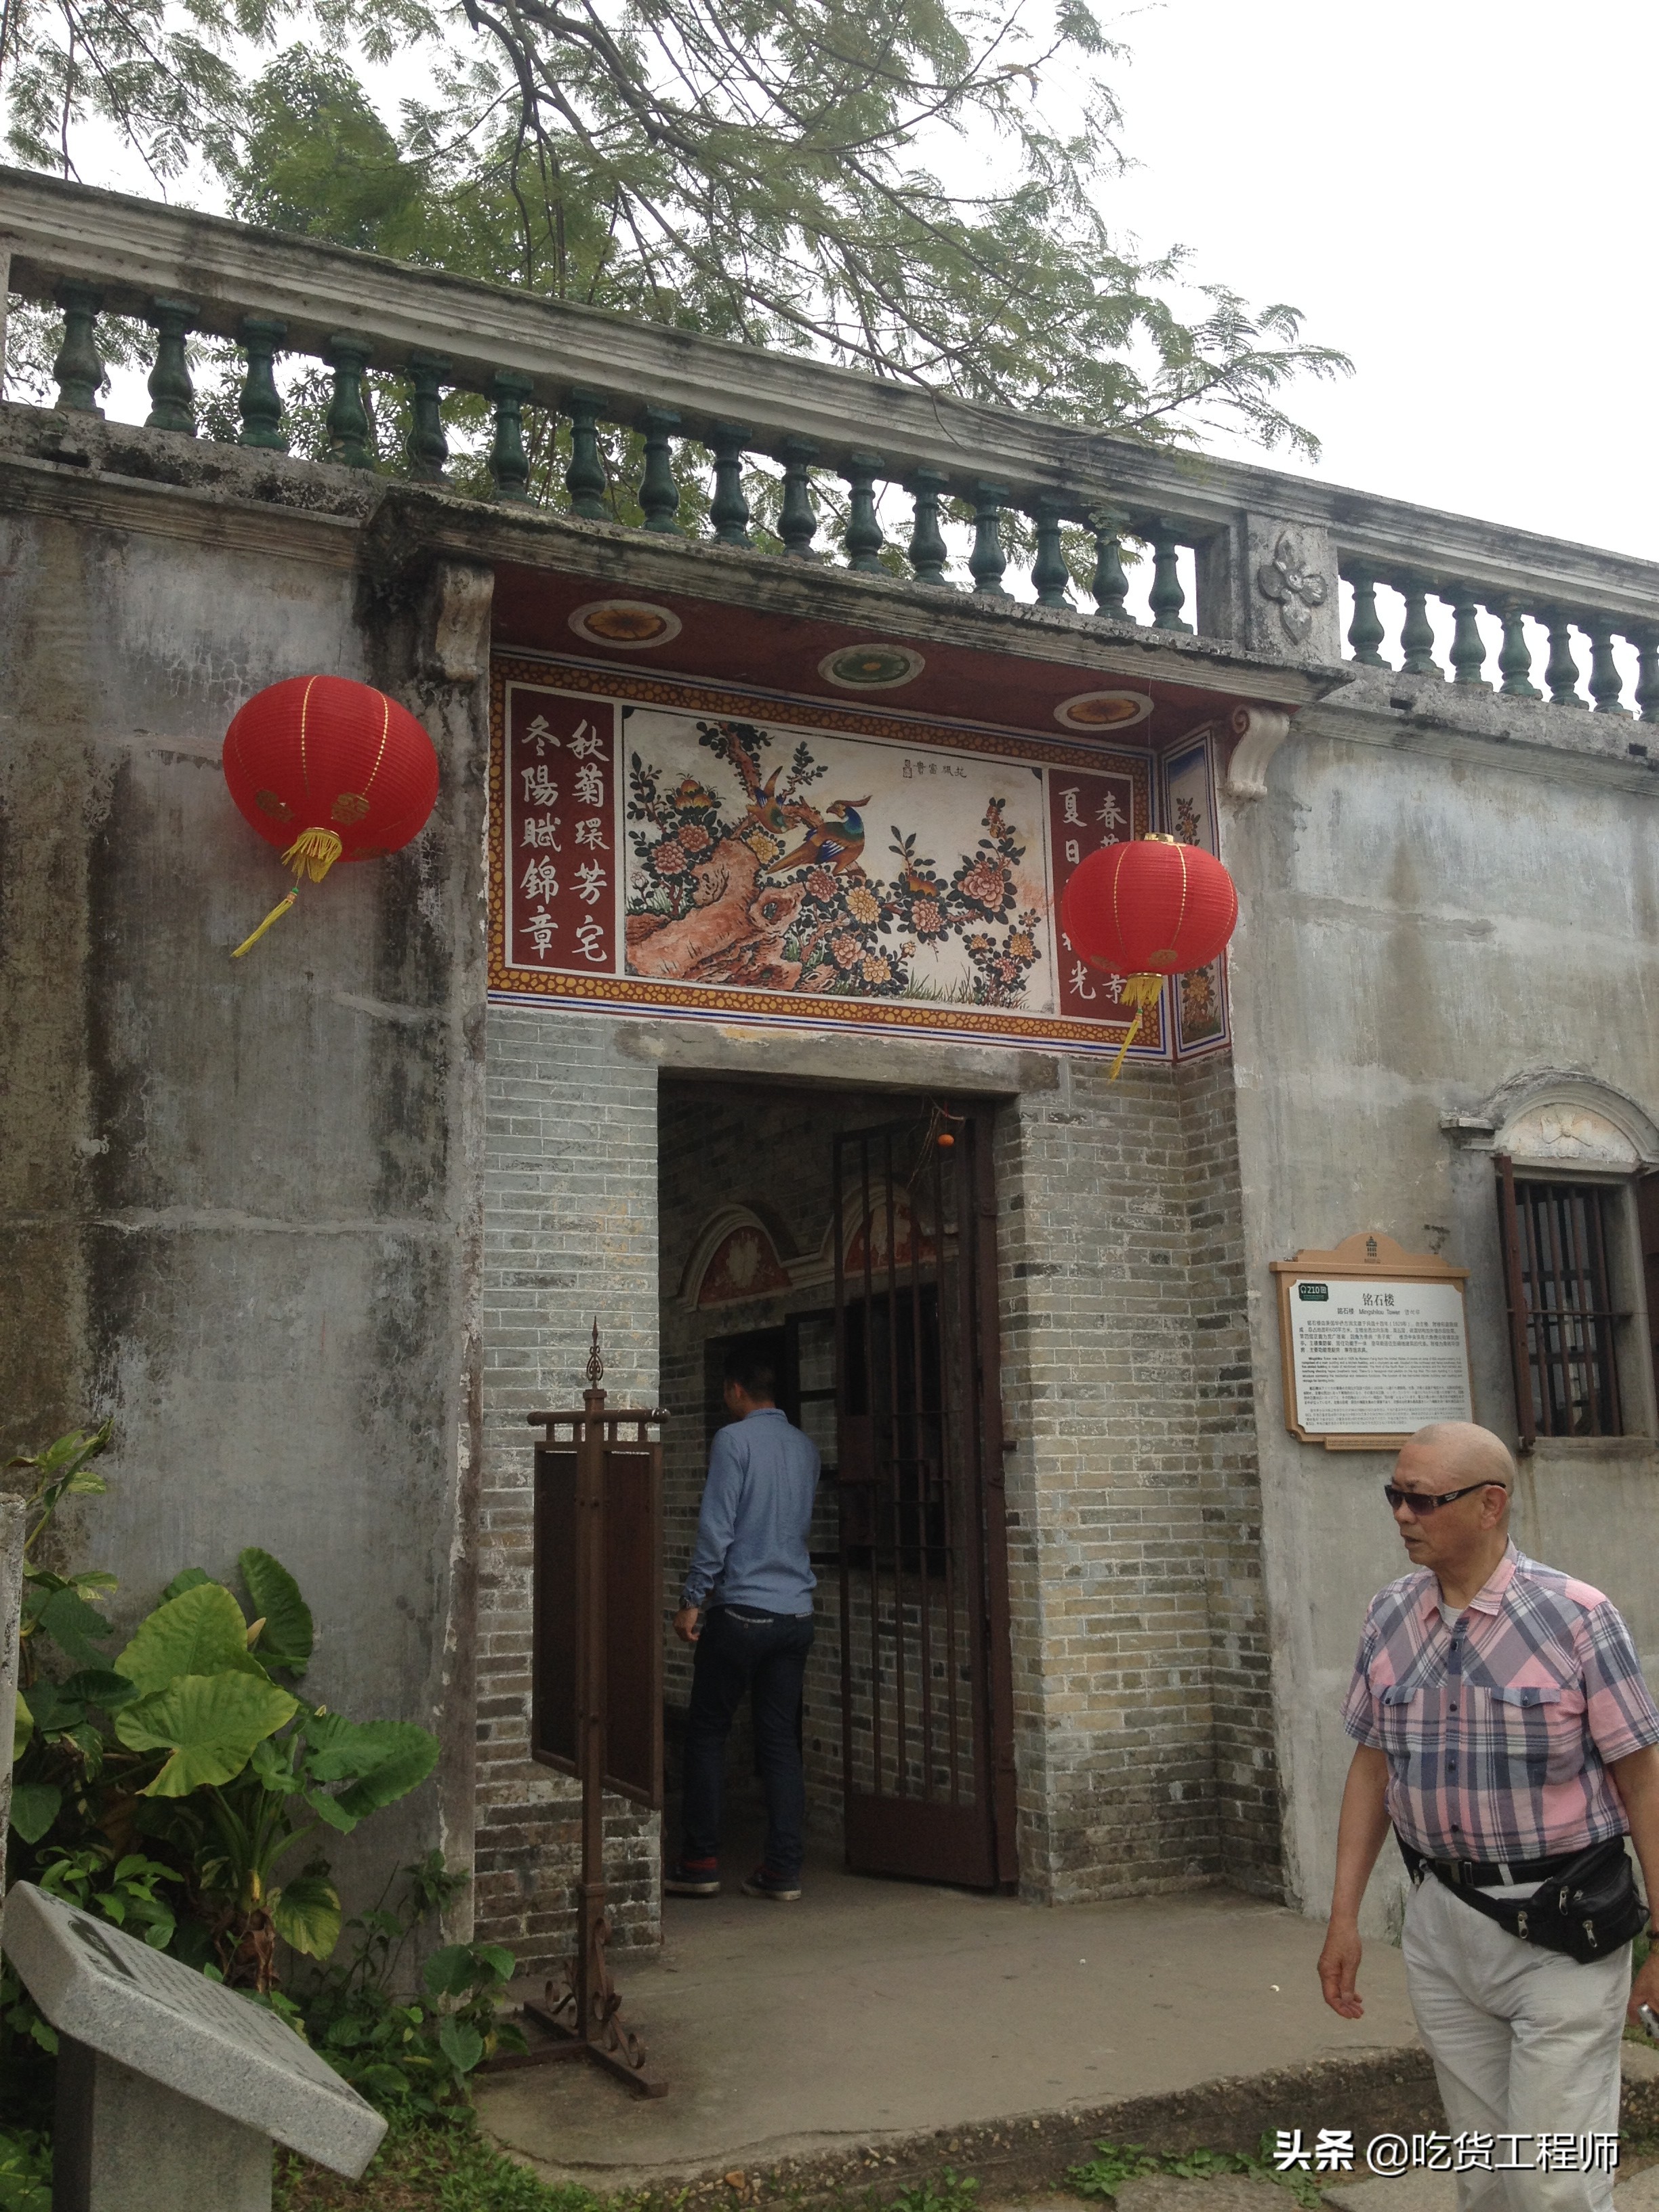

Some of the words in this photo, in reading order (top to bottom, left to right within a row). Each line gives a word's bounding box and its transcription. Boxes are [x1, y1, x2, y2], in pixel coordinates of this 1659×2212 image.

[520, 714, 561, 960] 冬陽賦錦章
[567, 719, 609, 962] 秋菊環芳宅
[1059, 787, 1097, 1000] 夏日光
[1307, 1286, 1320, 1294] 210
[1362, 1293, 1395, 1307] 铭石楼
